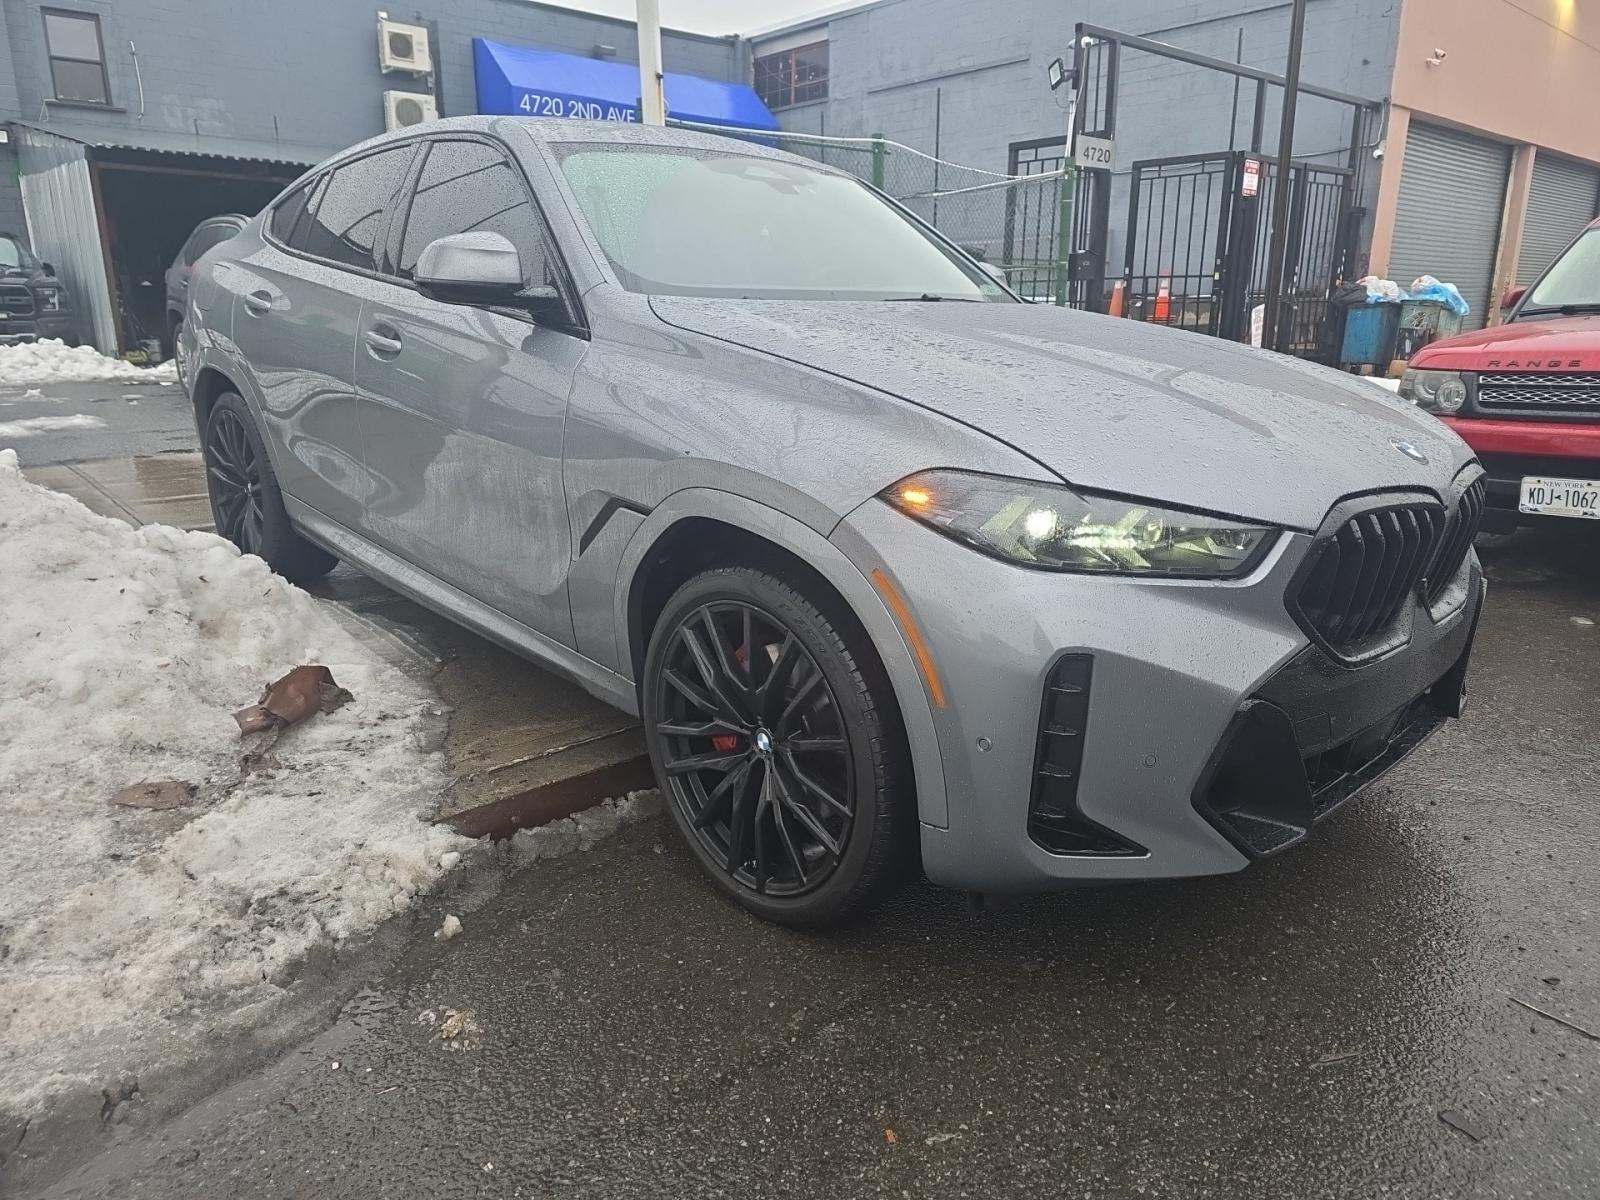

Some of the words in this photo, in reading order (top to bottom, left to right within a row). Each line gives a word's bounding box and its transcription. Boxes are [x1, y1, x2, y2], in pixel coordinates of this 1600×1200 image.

[520, 94, 563, 116] 4720
[568, 100, 602, 120] 2ND
[1083, 146, 1111, 163] 4720
[1487, 359, 1582, 368] RANGE
